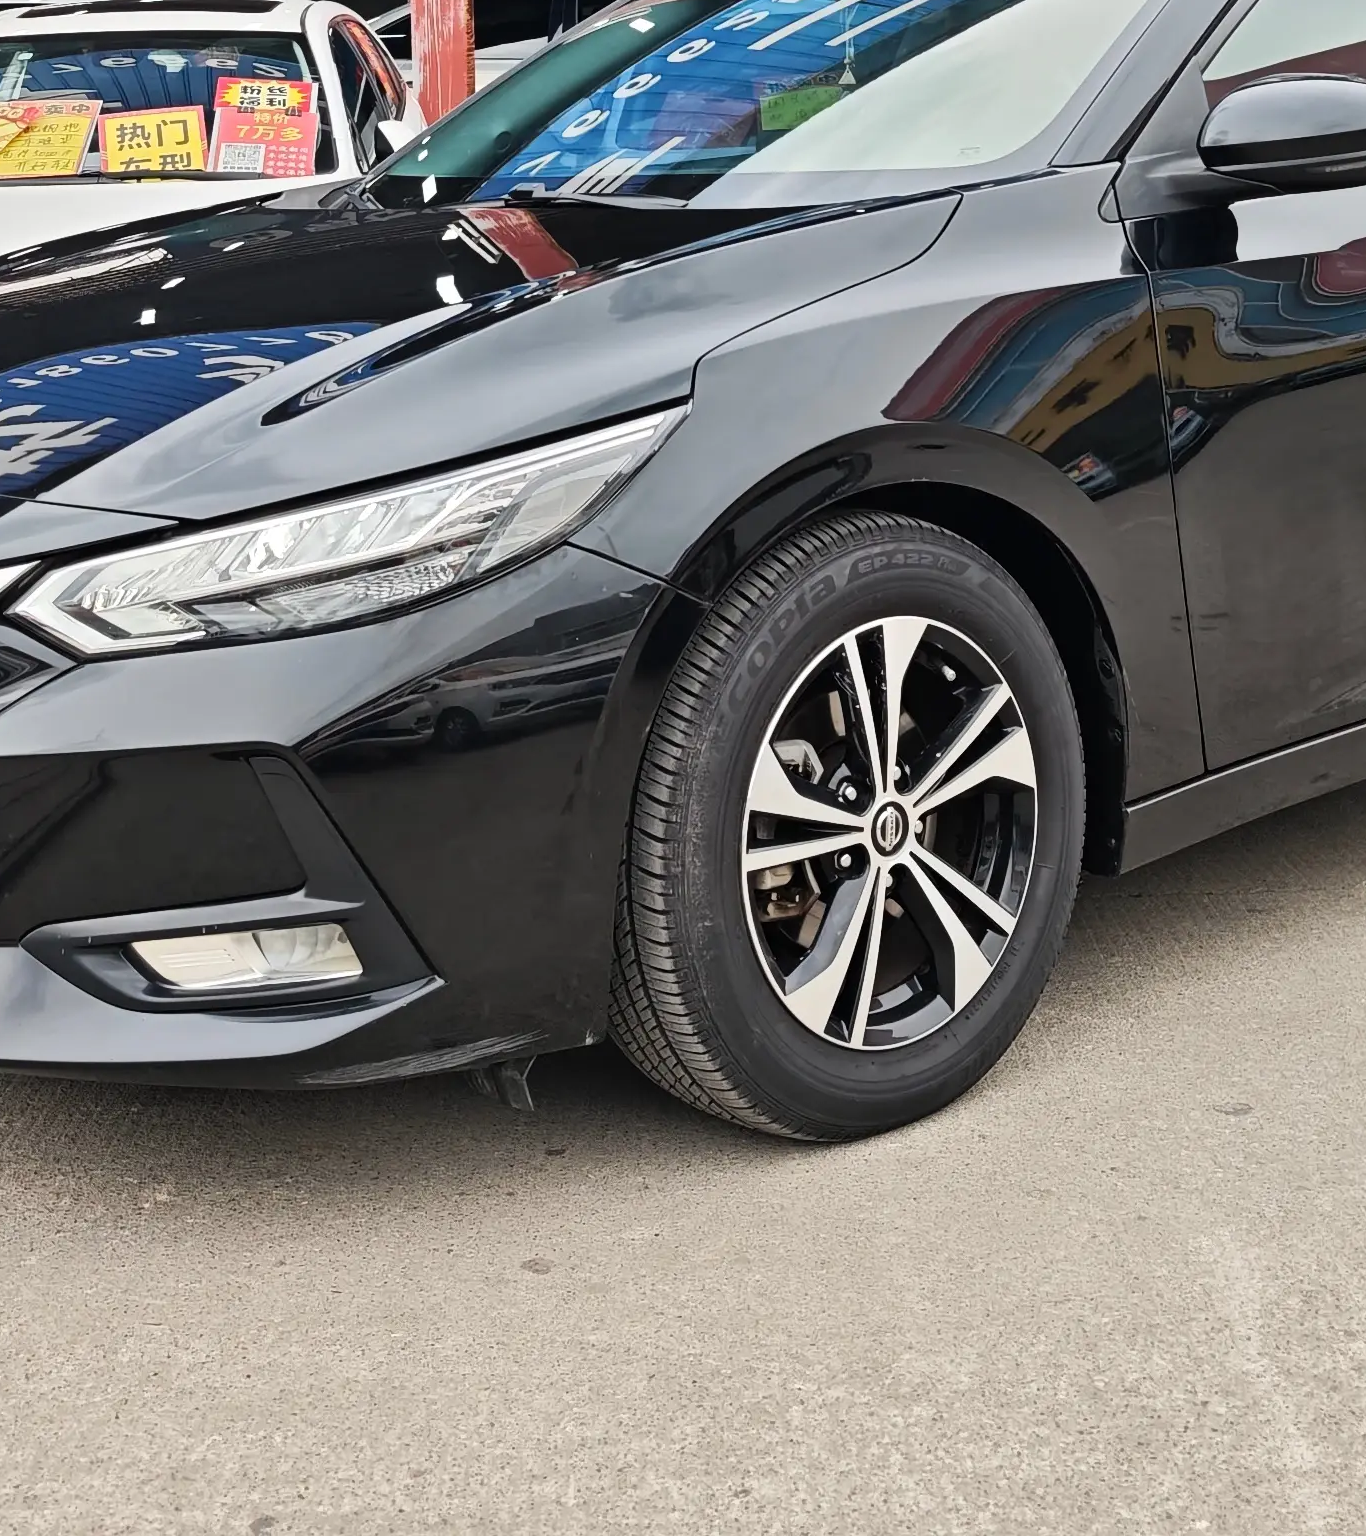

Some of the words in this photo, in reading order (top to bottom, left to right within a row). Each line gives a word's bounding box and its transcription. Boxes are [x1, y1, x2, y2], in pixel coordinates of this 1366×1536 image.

[240, 85, 288, 97] 粉丝
[253, 112, 290, 125] 特价
[116, 119, 189, 151] 热门
[236, 124, 304, 143] 7万多
